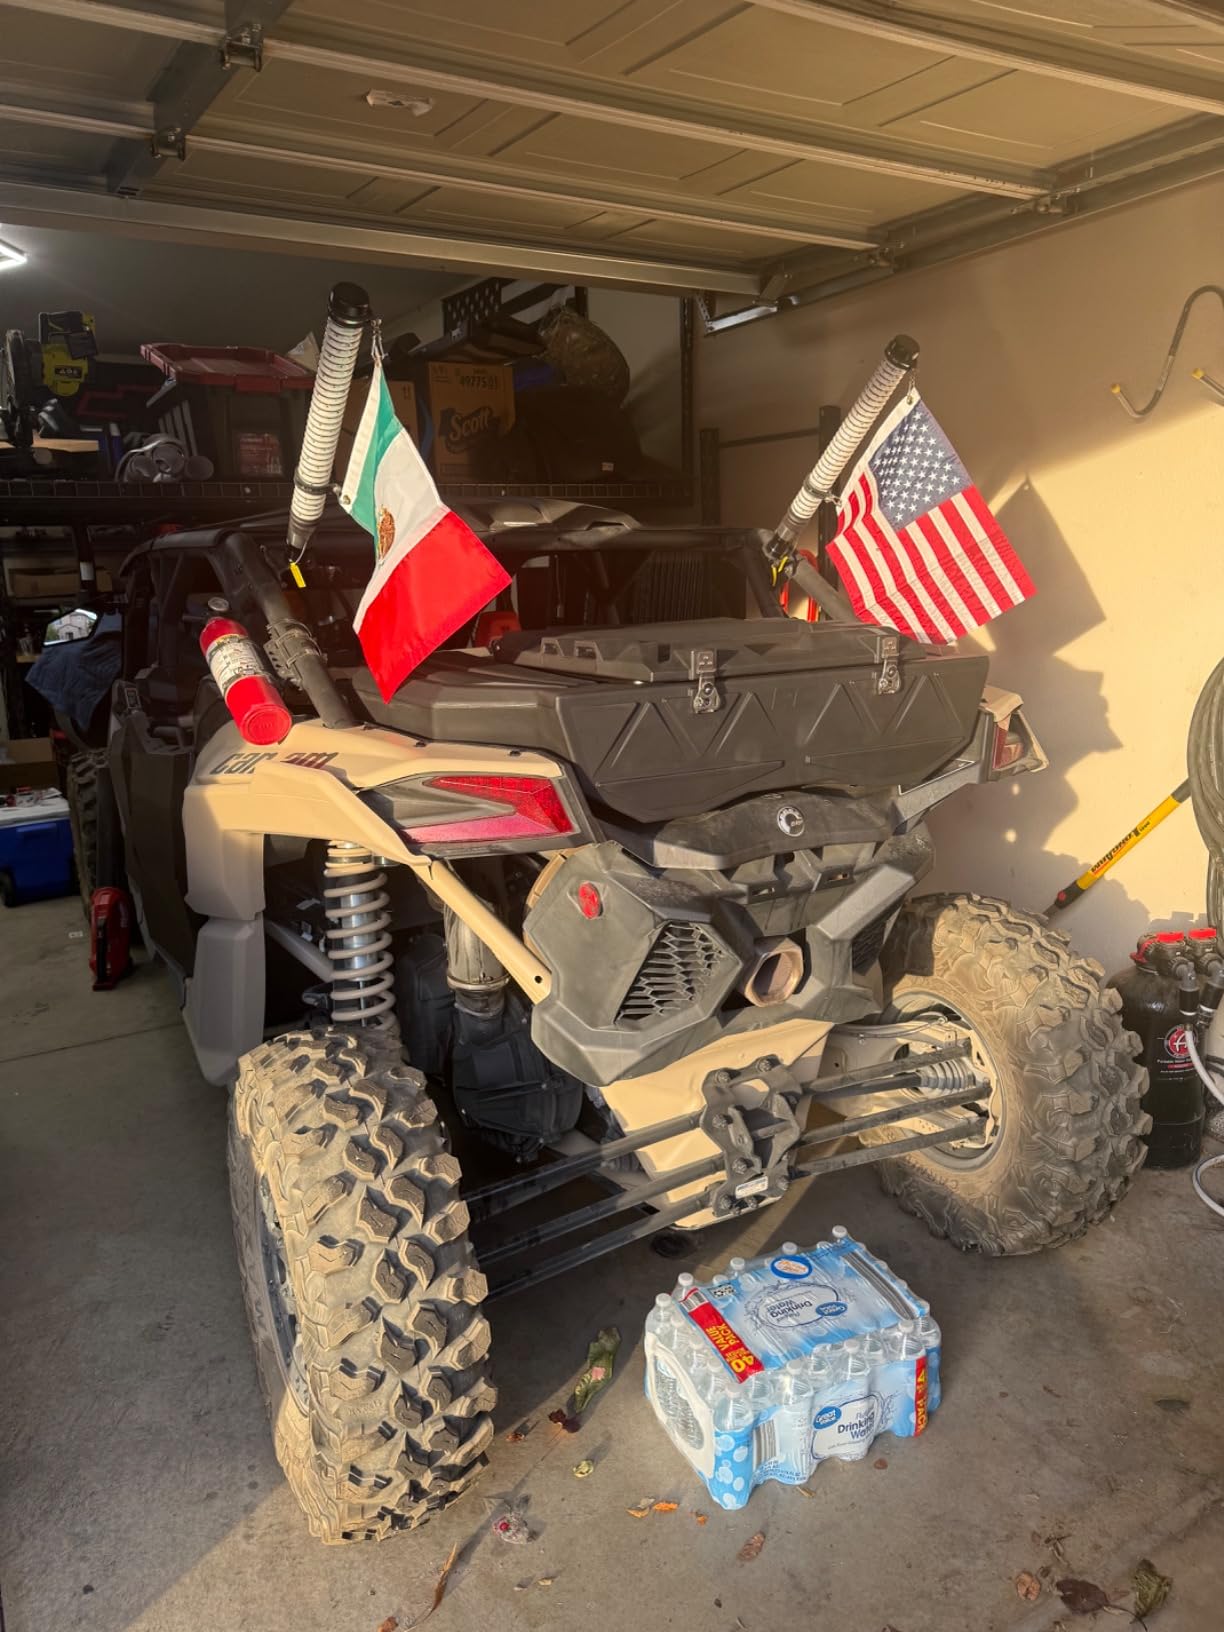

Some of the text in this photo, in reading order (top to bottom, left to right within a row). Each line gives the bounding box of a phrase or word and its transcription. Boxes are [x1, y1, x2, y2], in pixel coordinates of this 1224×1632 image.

[449, 406, 491, 441] Scott
[770, 1300, 813, 1318] Drinking
[718, 1323, 740, 1345] PACK
[850, 1422, 875, 1440] Wate
